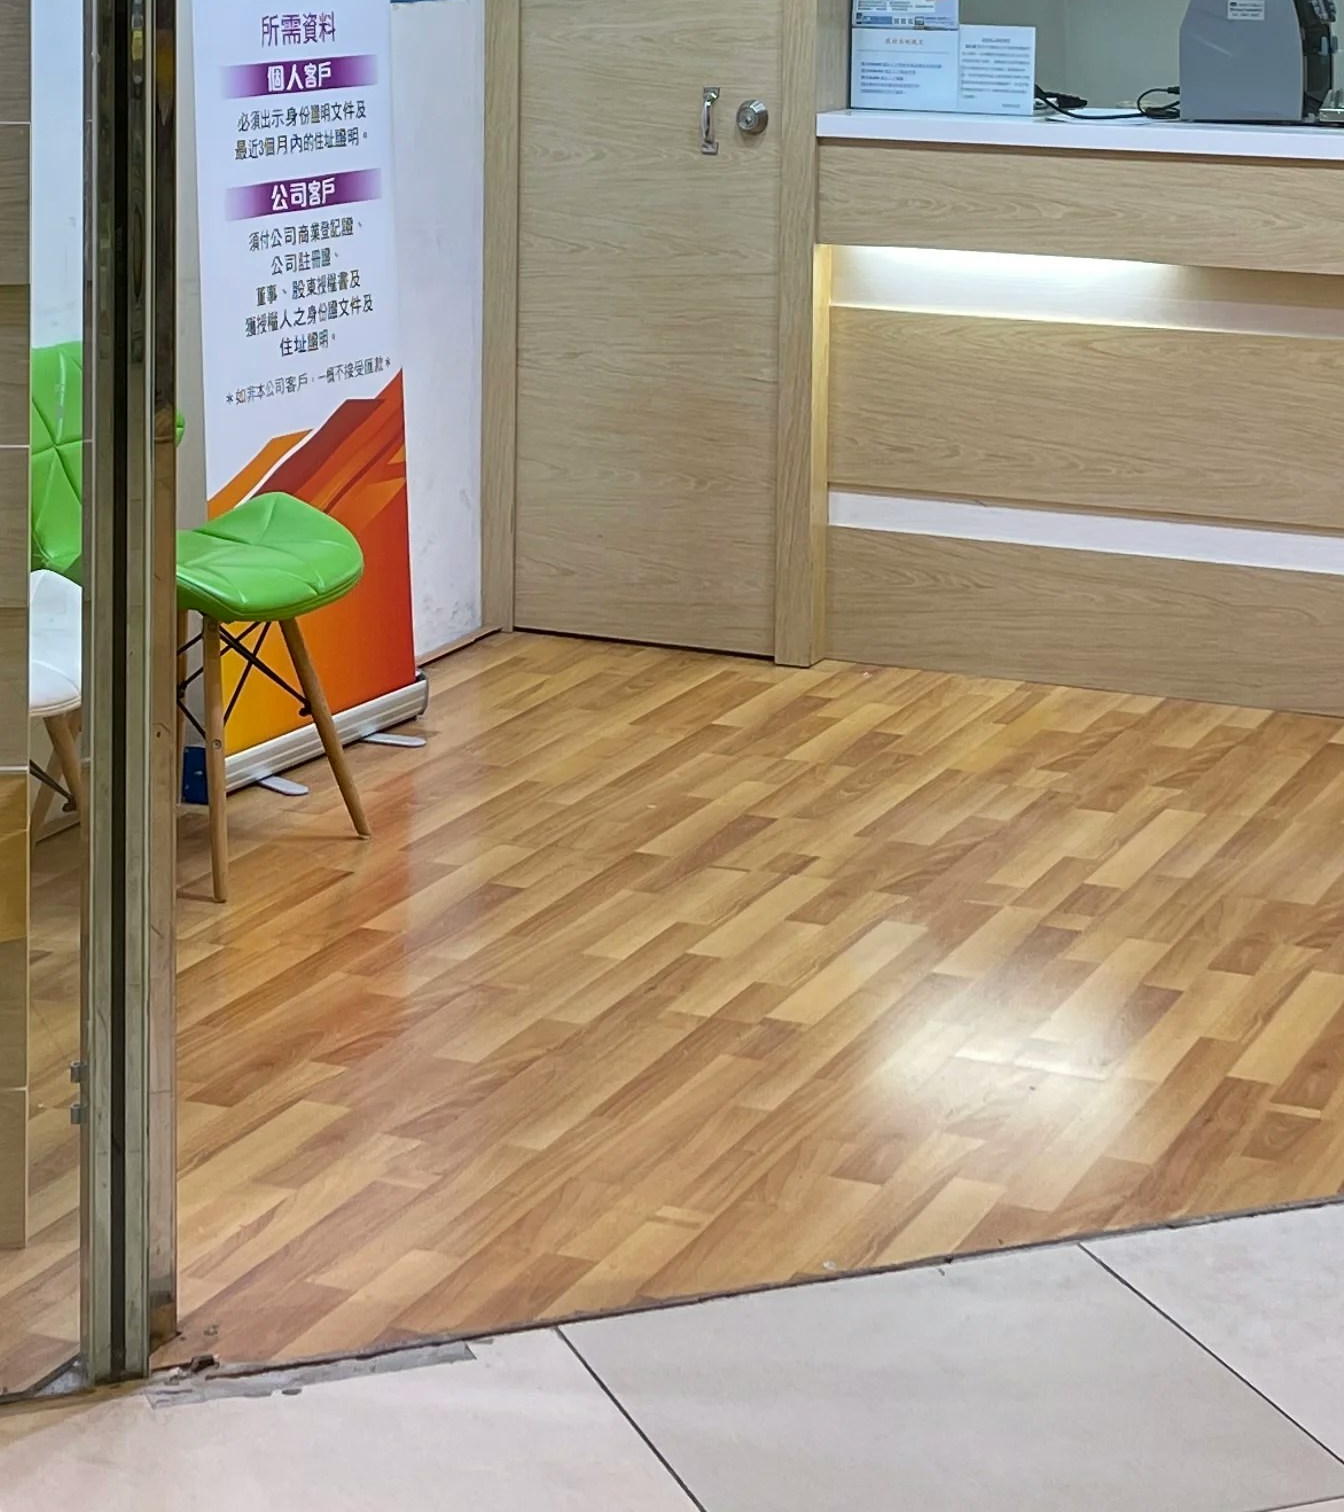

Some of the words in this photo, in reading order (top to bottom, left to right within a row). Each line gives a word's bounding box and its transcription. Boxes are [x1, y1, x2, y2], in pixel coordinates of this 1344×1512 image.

[261, 11, 336, 47] 所需資料
[267, 61, 332, 92] 個人客戶
[271, 177, 336, 211] 公司客戶
